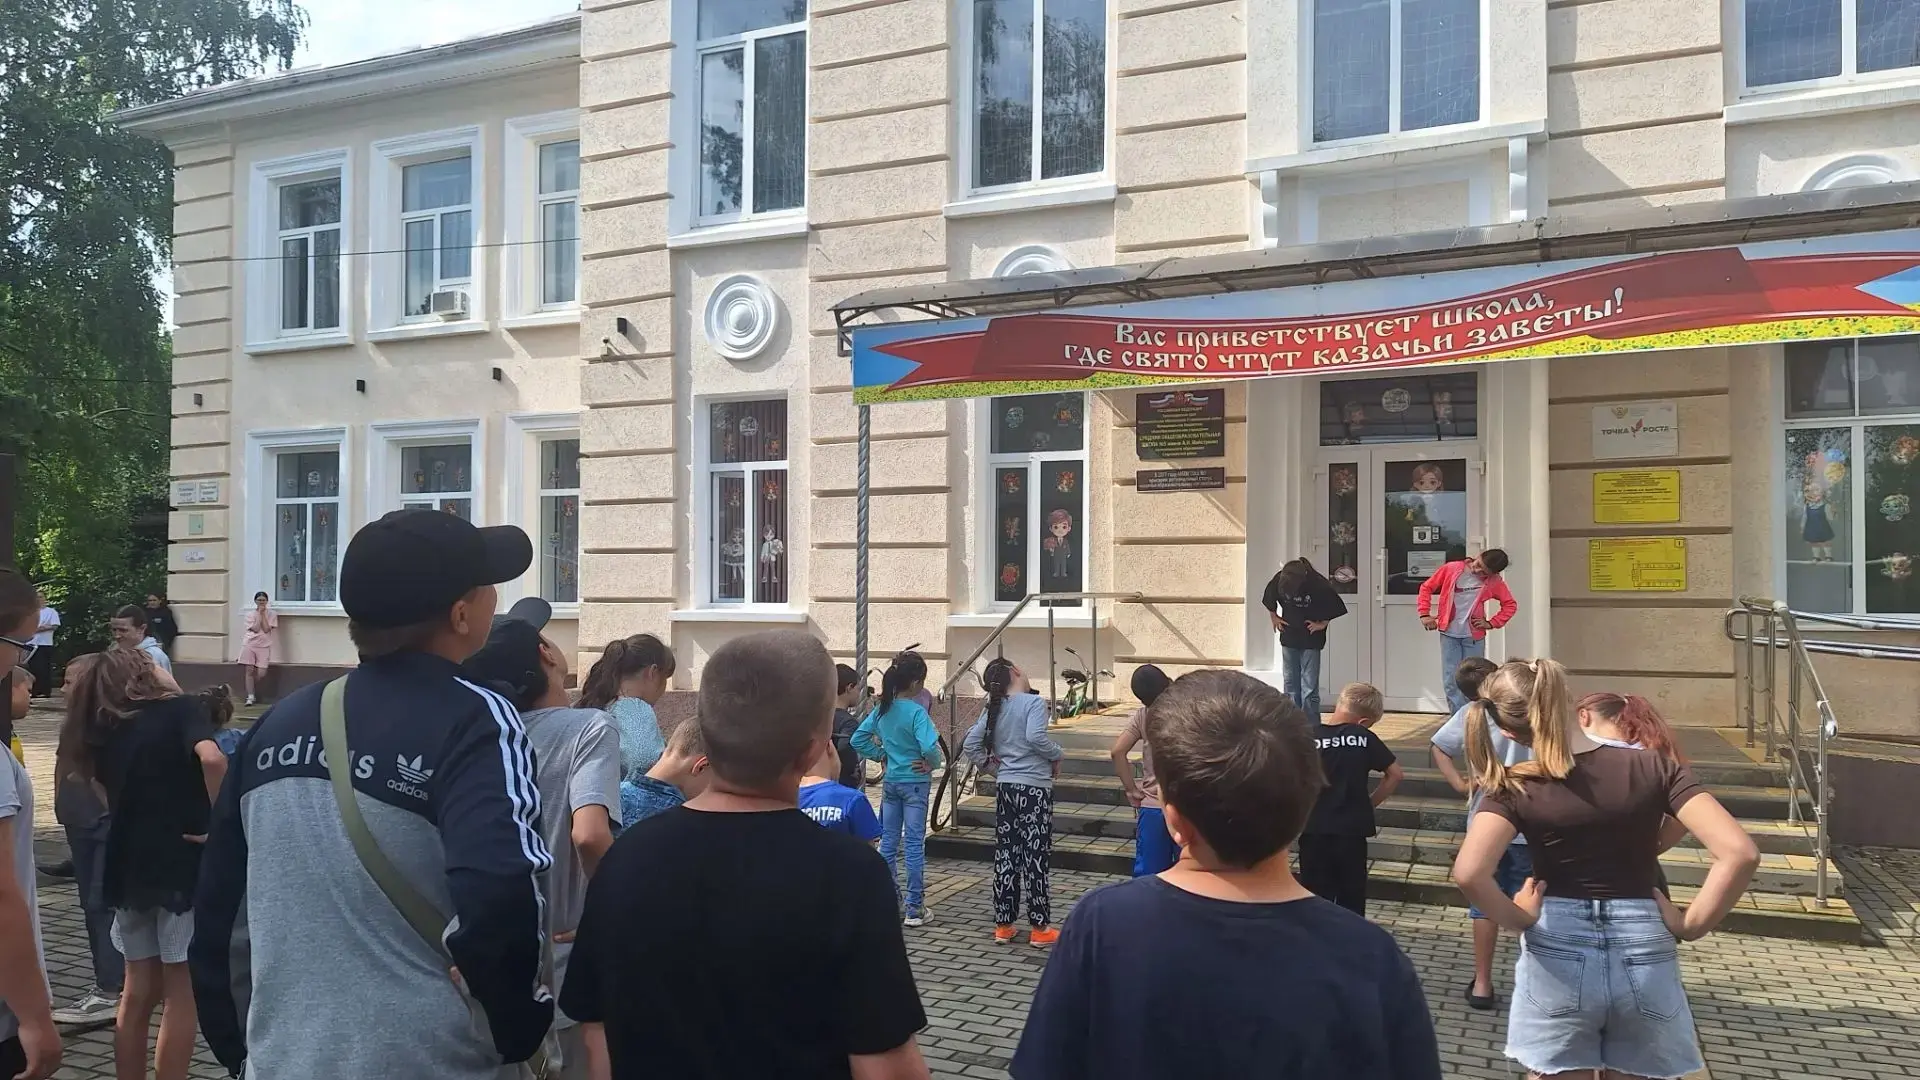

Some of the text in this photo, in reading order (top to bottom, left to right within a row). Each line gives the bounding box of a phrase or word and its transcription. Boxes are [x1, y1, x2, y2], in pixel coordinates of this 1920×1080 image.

[1601, 428, 1630, 436] ТОЧКА
[256, 736, 375, 779] adis
[387, 777, 429, 801] adidas
[801, 806, 843, 822] GHTER
